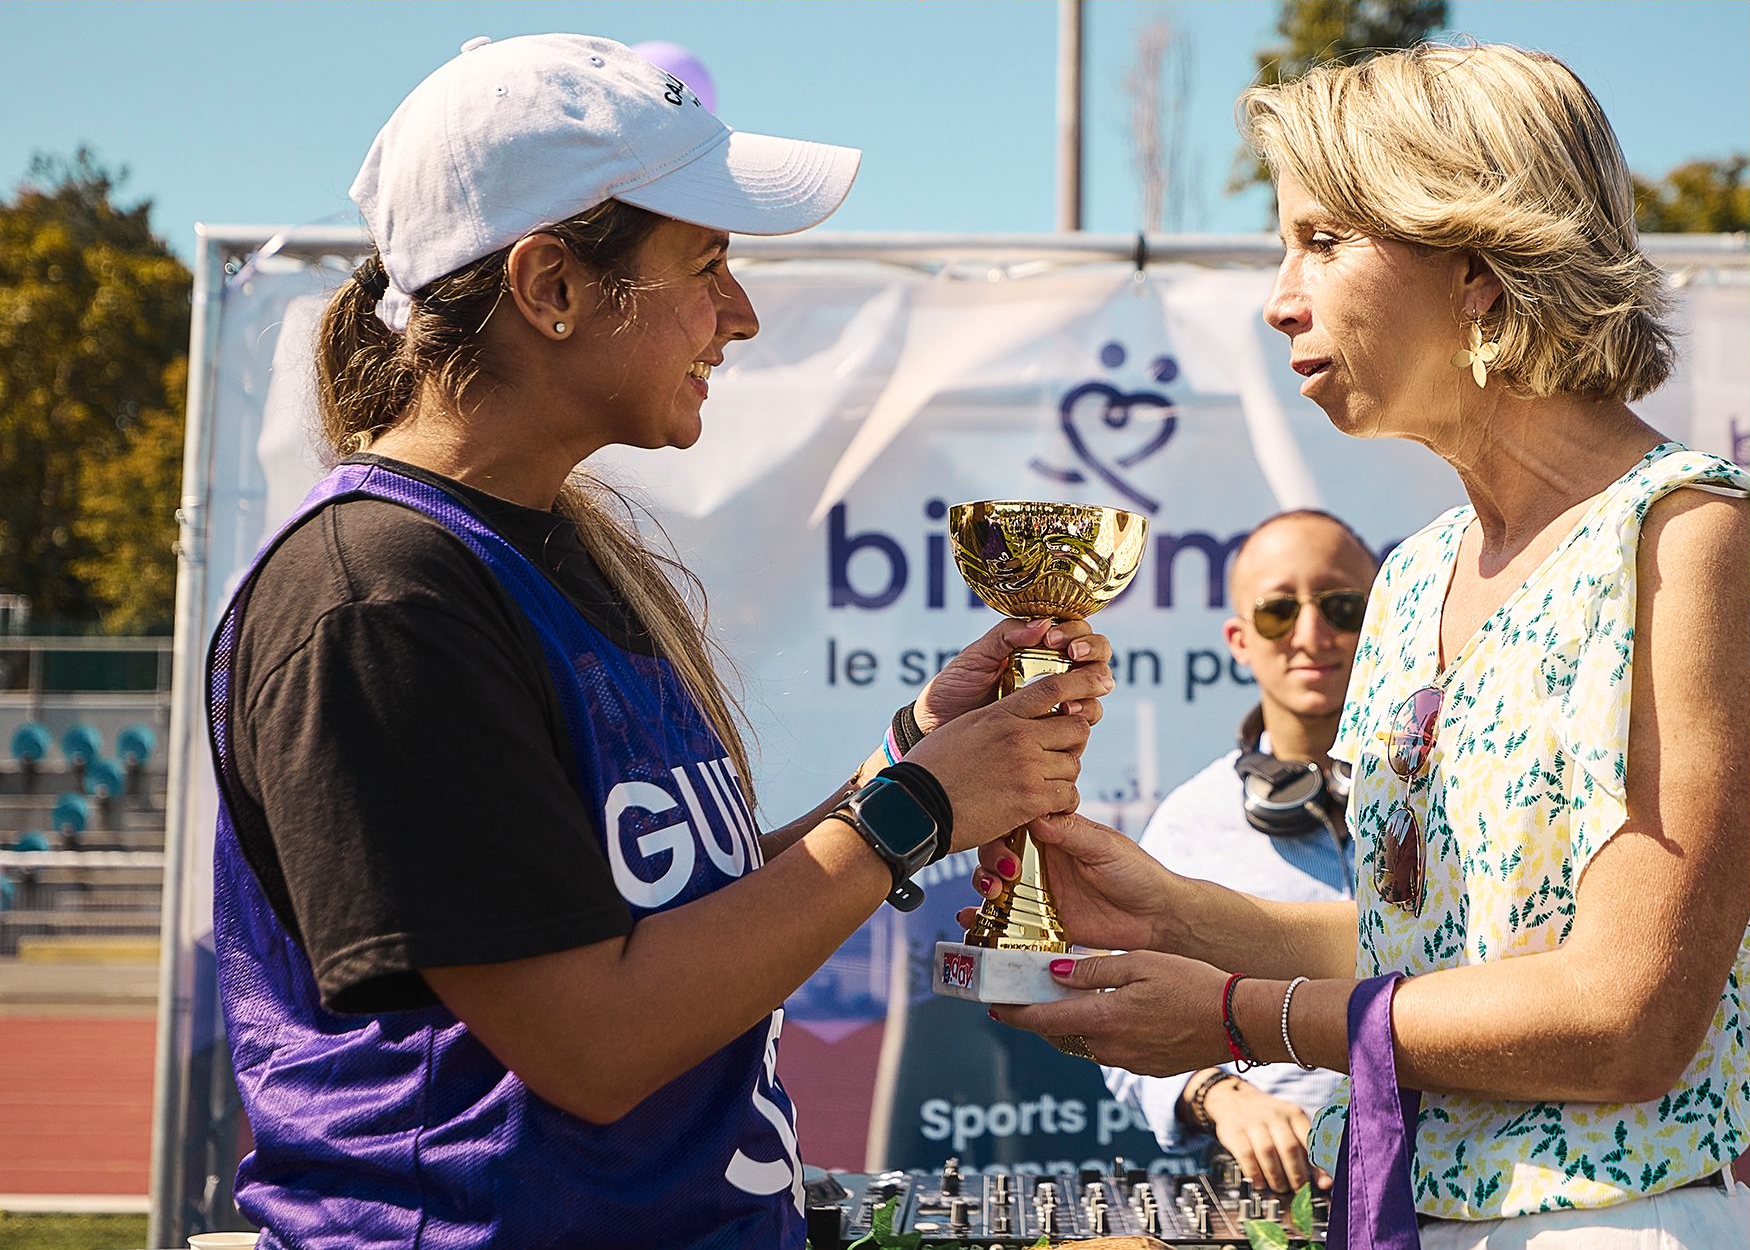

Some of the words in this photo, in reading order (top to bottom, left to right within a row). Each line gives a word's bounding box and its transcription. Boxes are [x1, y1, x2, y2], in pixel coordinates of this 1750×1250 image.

[826, 636, 878, 688] le
[1117, 658, 1173, 688] en
[919, 1097, 1087, 1150] Sports
